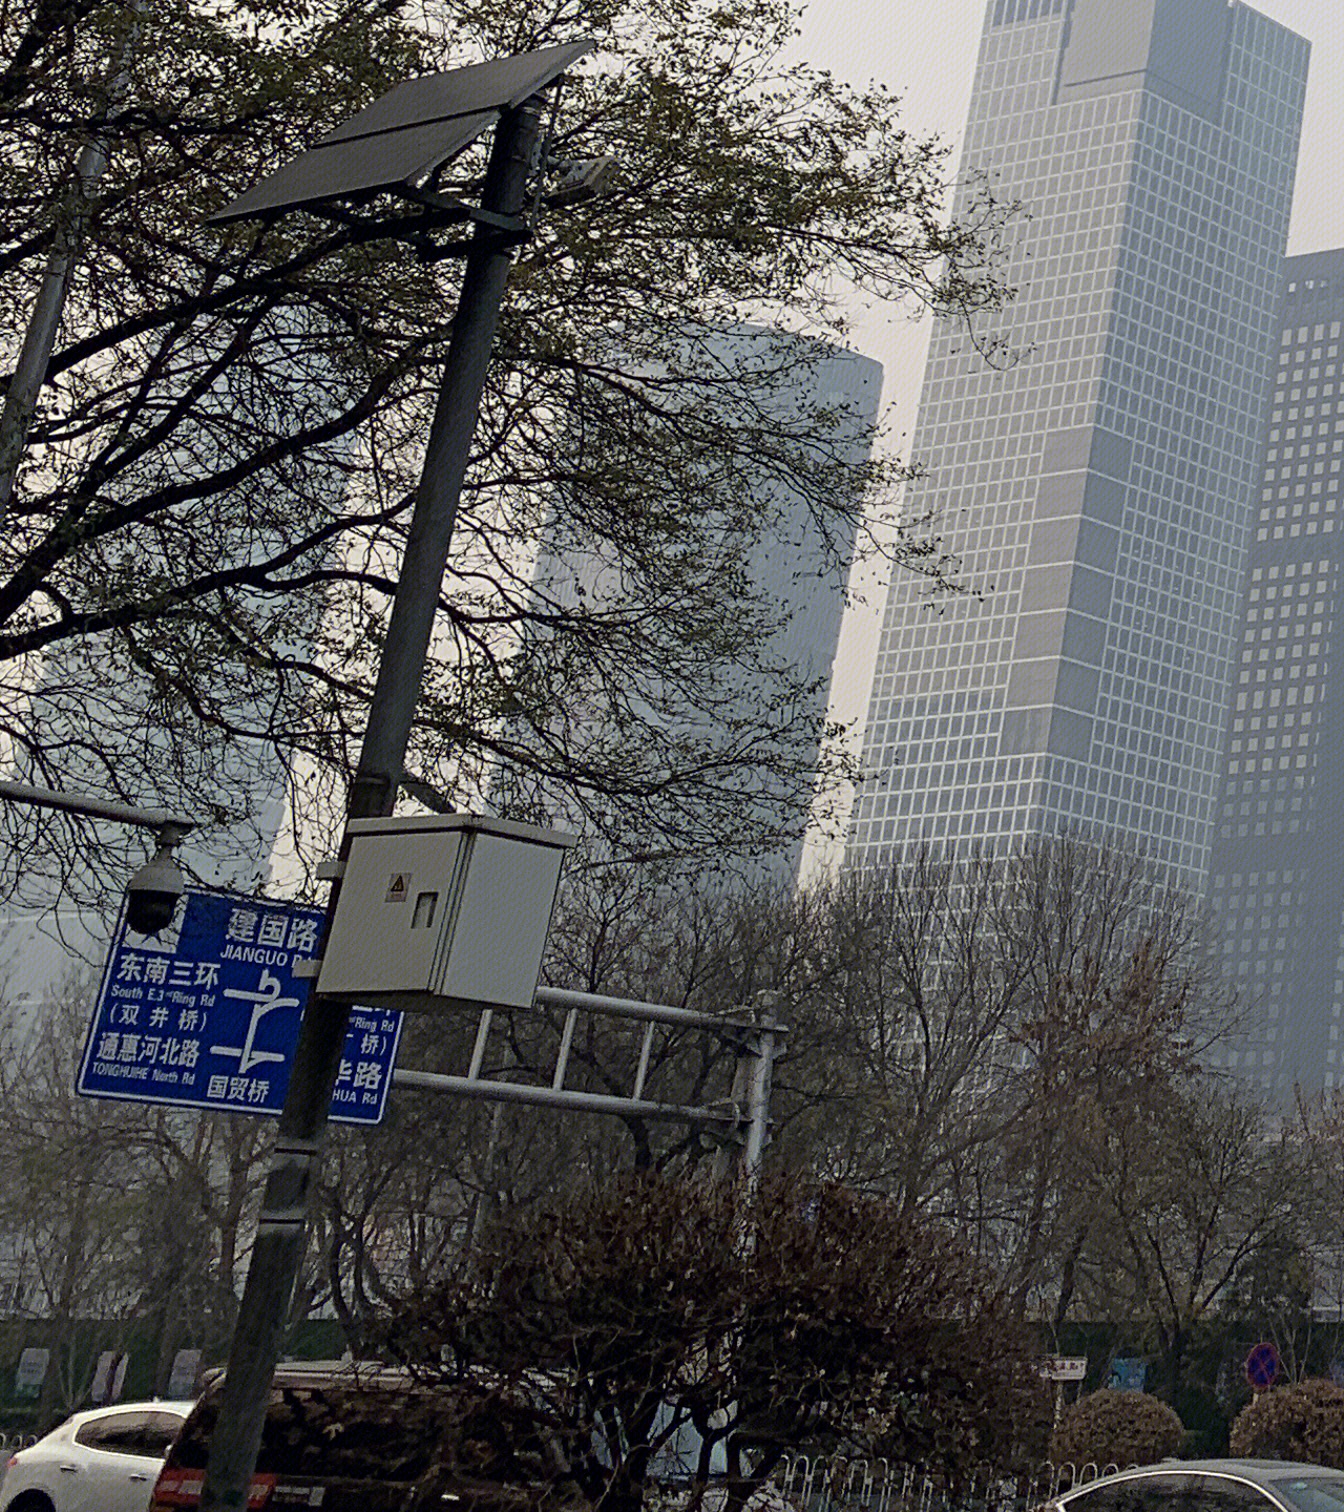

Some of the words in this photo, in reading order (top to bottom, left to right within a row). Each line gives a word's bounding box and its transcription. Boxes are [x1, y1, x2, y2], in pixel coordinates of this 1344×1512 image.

[225, 908, 318, 953] 建国路
[220, 944, 288, 967] JIANGUO
[116, 952, 221, 991] 东南三环
[111, 983, 143, 999] South
[200, 993, 216, 1007] Rd
[381, 1019, 395, 1032] Rd
[96, 1032, 201, 1068] 通惠河北路
[92, 1062, 150, 1080] TONGHUIHE
[152, 1069, 179, 1083] North
[182, 1071, 196, 1085] Rd
[207, 1075, 270, 1103] 国贸桥
[332, 1088, 357, 1103] HUA
[362, 1091, 378, 1105] Rd
